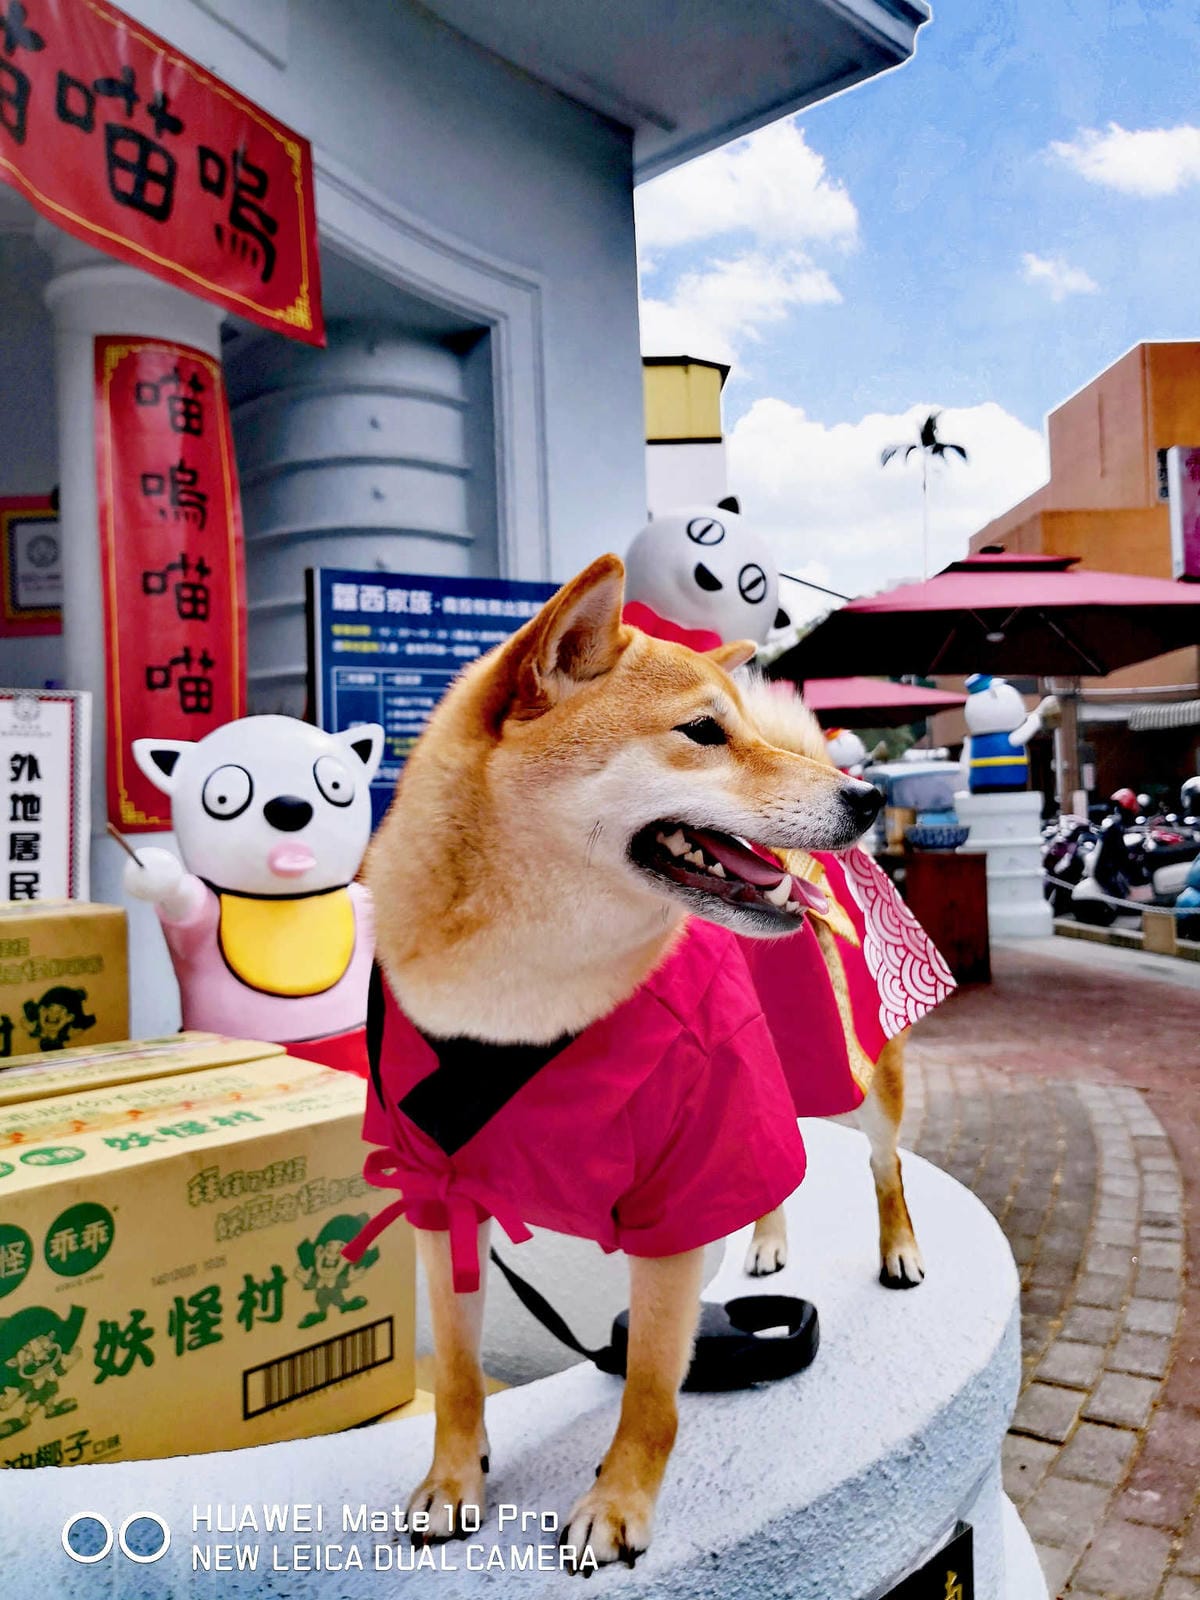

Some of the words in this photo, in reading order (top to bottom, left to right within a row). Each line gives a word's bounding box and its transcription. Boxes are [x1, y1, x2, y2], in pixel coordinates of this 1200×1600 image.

[135, 368, 214, 715] 喵嗚喵喵
[9, 753, 42, 900] 外地居民
[102, 1109, 264, 1153] 妖怪村
[49, 1219, 109, 1263] 乖乖
[93, 1263, 288, 1385] 妖怪村
